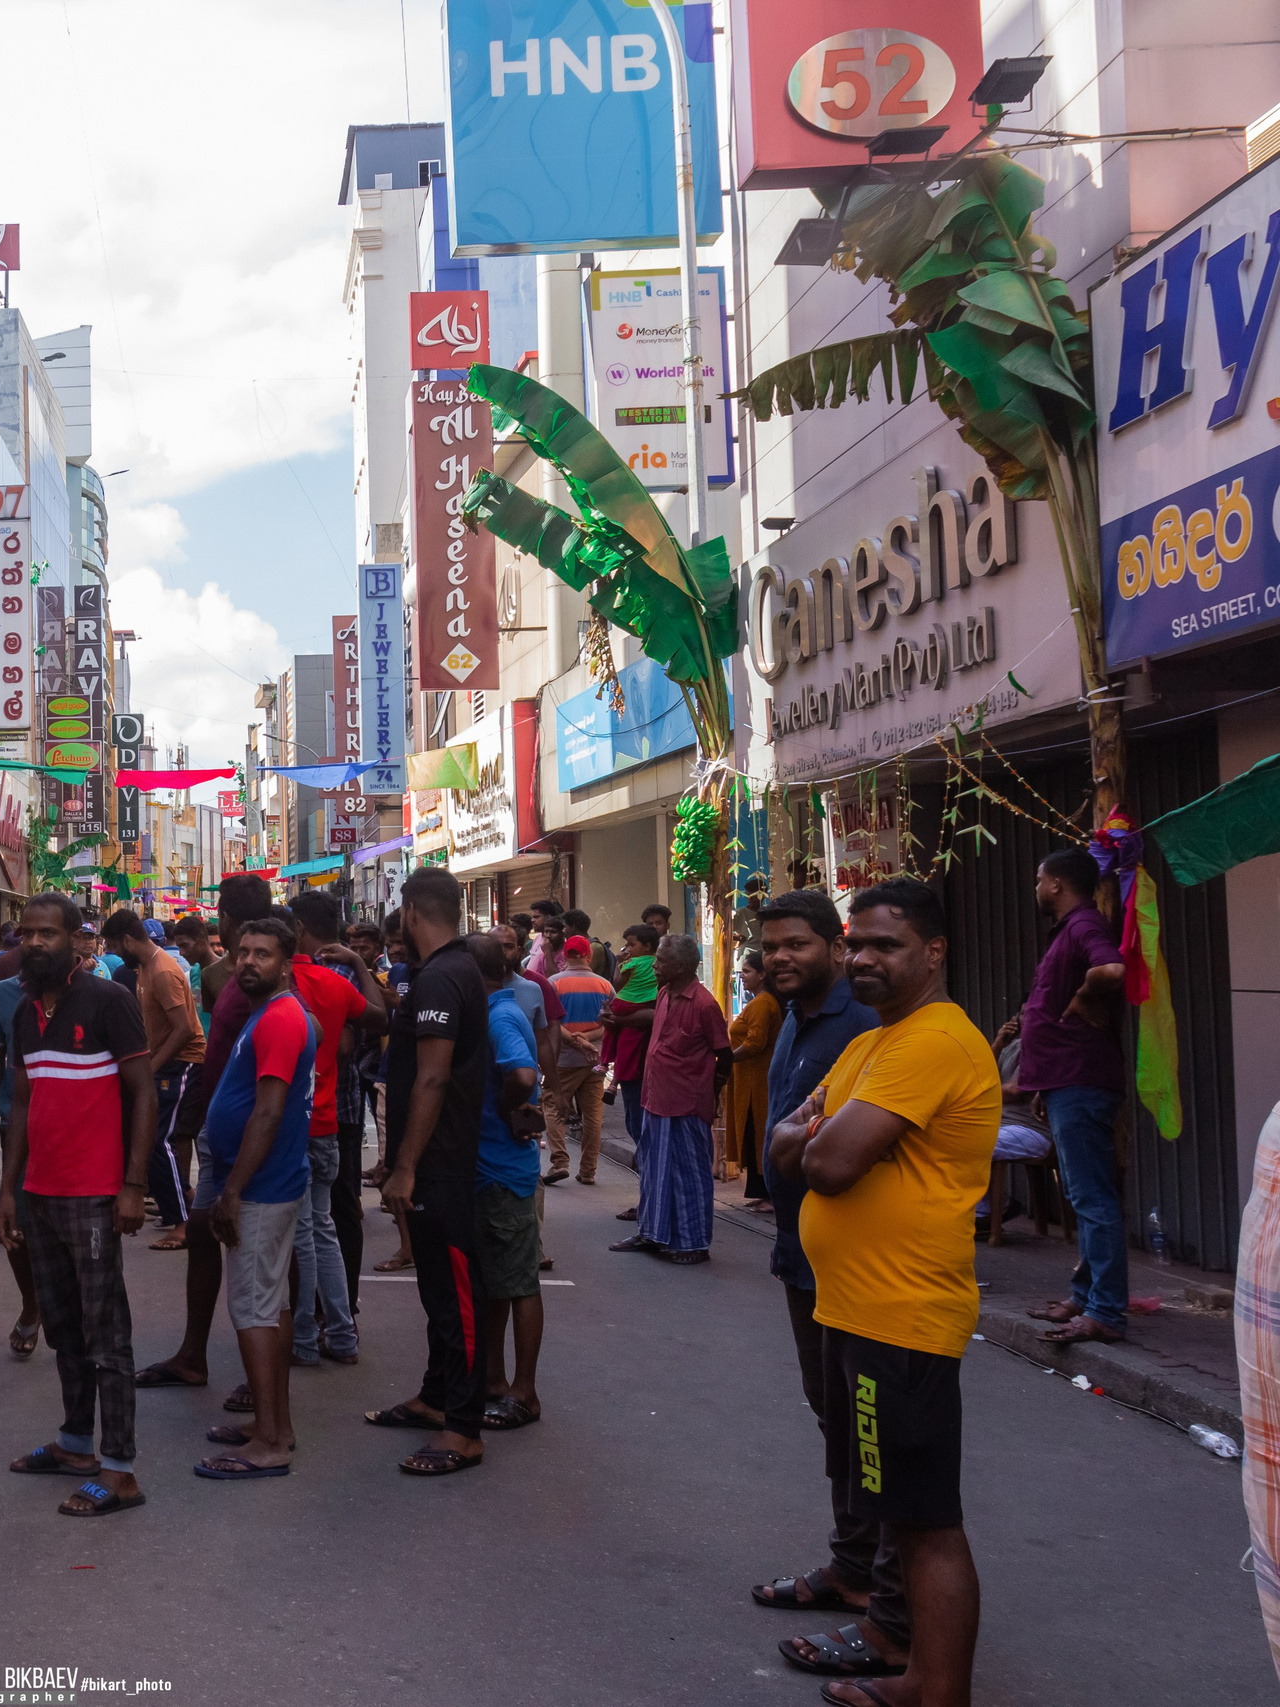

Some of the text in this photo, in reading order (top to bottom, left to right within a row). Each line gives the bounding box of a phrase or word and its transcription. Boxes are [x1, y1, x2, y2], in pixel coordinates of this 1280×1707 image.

[489, 33, 661, 97] HNB
[820, 43, 929, 121] 52
[608, 290, 643, 304] HNB
[636, 326, 683, 338] MoneyGr
[635, 365, 715, 379] WorldRit
[417, 381, 454, 406] Kay
[618, 407, 671, 418] WESTERN
[635, 415, 671, 424] UNION
[429, 404, 479, 446] Al
[628, 443, 667, 470] ria
[749, 464, 1018, 682] Ganesha
[1171, 612, 1200, 639] SEA
[1200, 592, 1262, 629] STREET,
[77, 619, 100, 696] RAV
[446, 653, 475, 671] 62
[372, 602, 392, 763] JEWELLERY
[764, 682, 841, 746] Jewellery
[842, 652, 890, 713] Mart
[891, 623, 947, 702] (Pvt)
[949, 605, 996, 673] Ltd
[120, 749, 136, 822] DVI
[377, 769, 394, 783] 74
[343, 796, 367, 814] 82
[80, 823, 100, 832] 115
[121, 829, 136, 838] 131
[334, 829, 353, 842] 88
[417, 1009, 450, 1024] NIKE
[855, 1373, 882, 1494] RIDER
